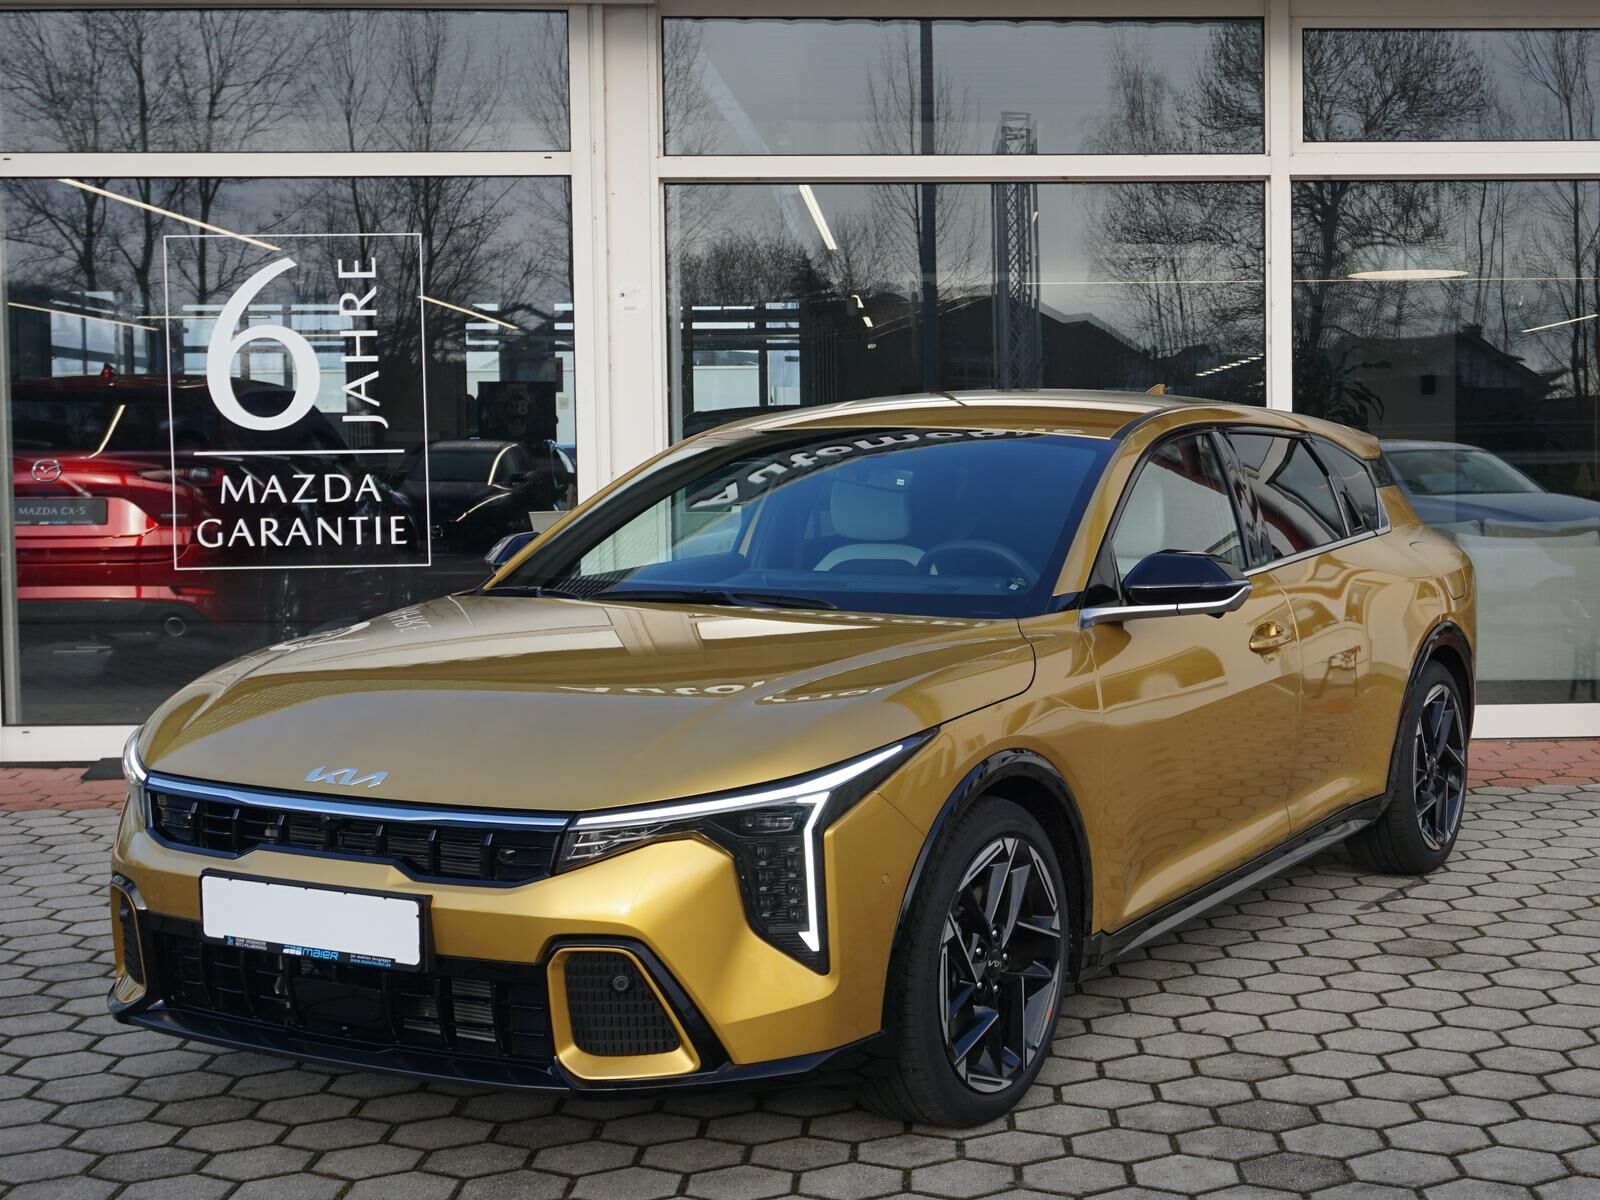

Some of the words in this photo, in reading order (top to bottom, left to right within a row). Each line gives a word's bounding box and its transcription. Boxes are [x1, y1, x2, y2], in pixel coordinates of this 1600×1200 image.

[207, 257, 321, 431] 6
[338, 257, 389, 429] JAHRE
[220, 473, 382, 504] MAZDA
[18, 506, 58, 516] MAZDA
[60, 505, 87, 516] CX-5
[197, 515, 408, 548] GARANTIE
[304, 765, 389, 788] KIA
